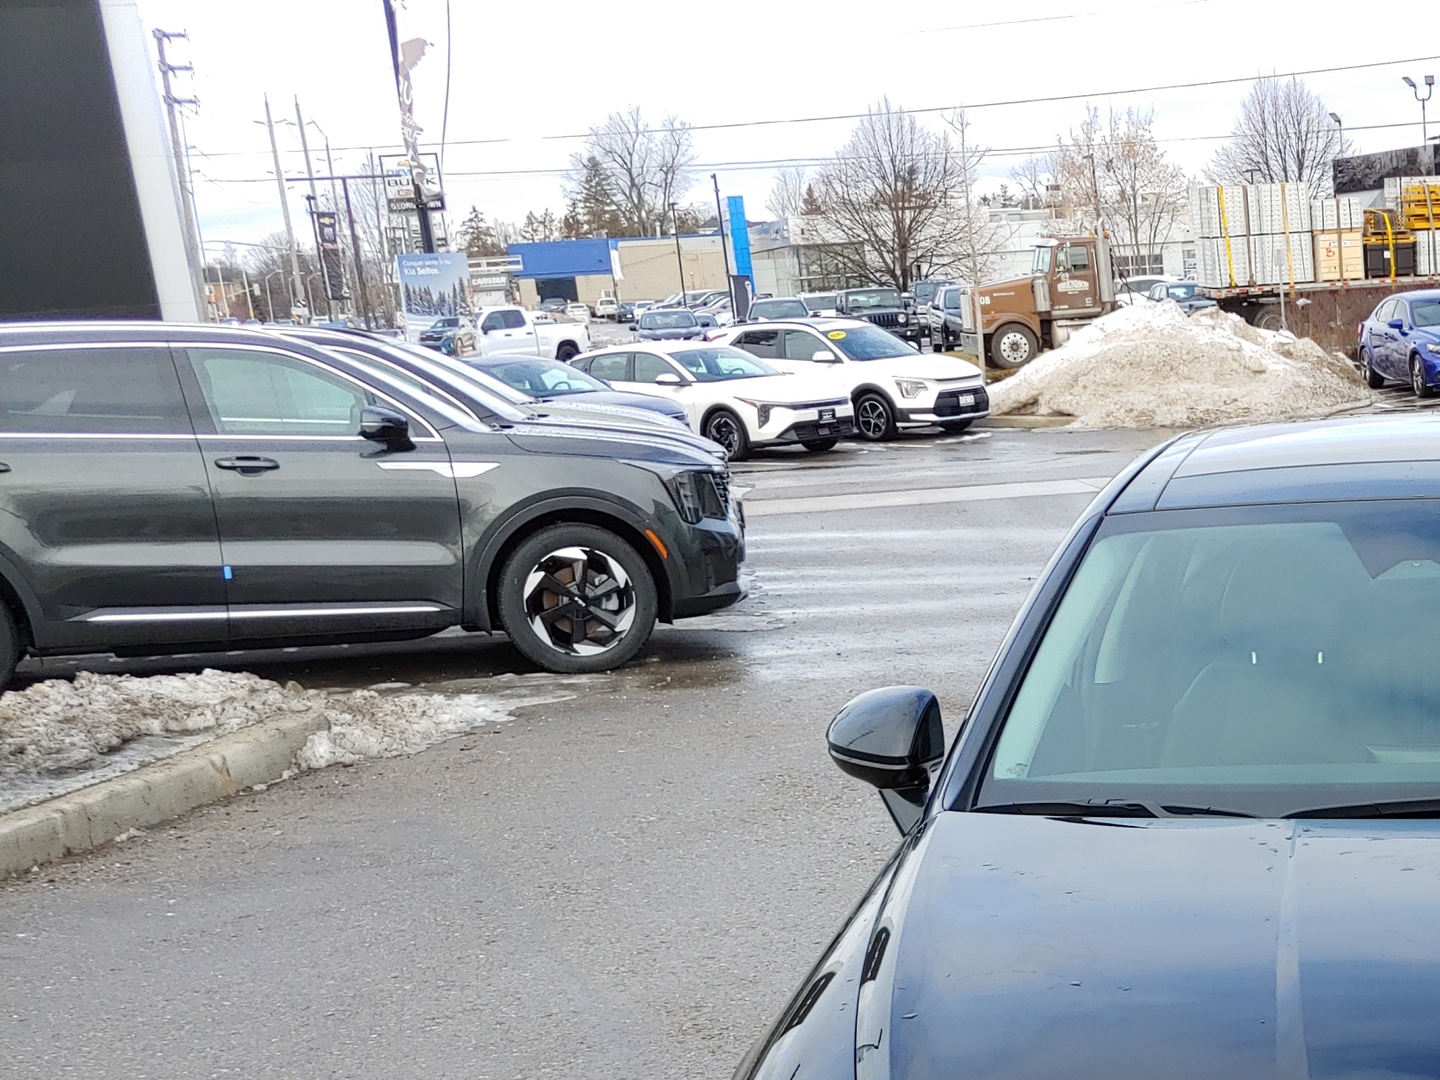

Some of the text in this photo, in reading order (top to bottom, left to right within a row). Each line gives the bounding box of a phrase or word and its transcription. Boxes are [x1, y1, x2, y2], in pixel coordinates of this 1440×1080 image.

[387, 176, 438, 188] BUK
[404, 266, 439, 275] Kia Seltos
[471, 276, 507, 285] CARSTAR
